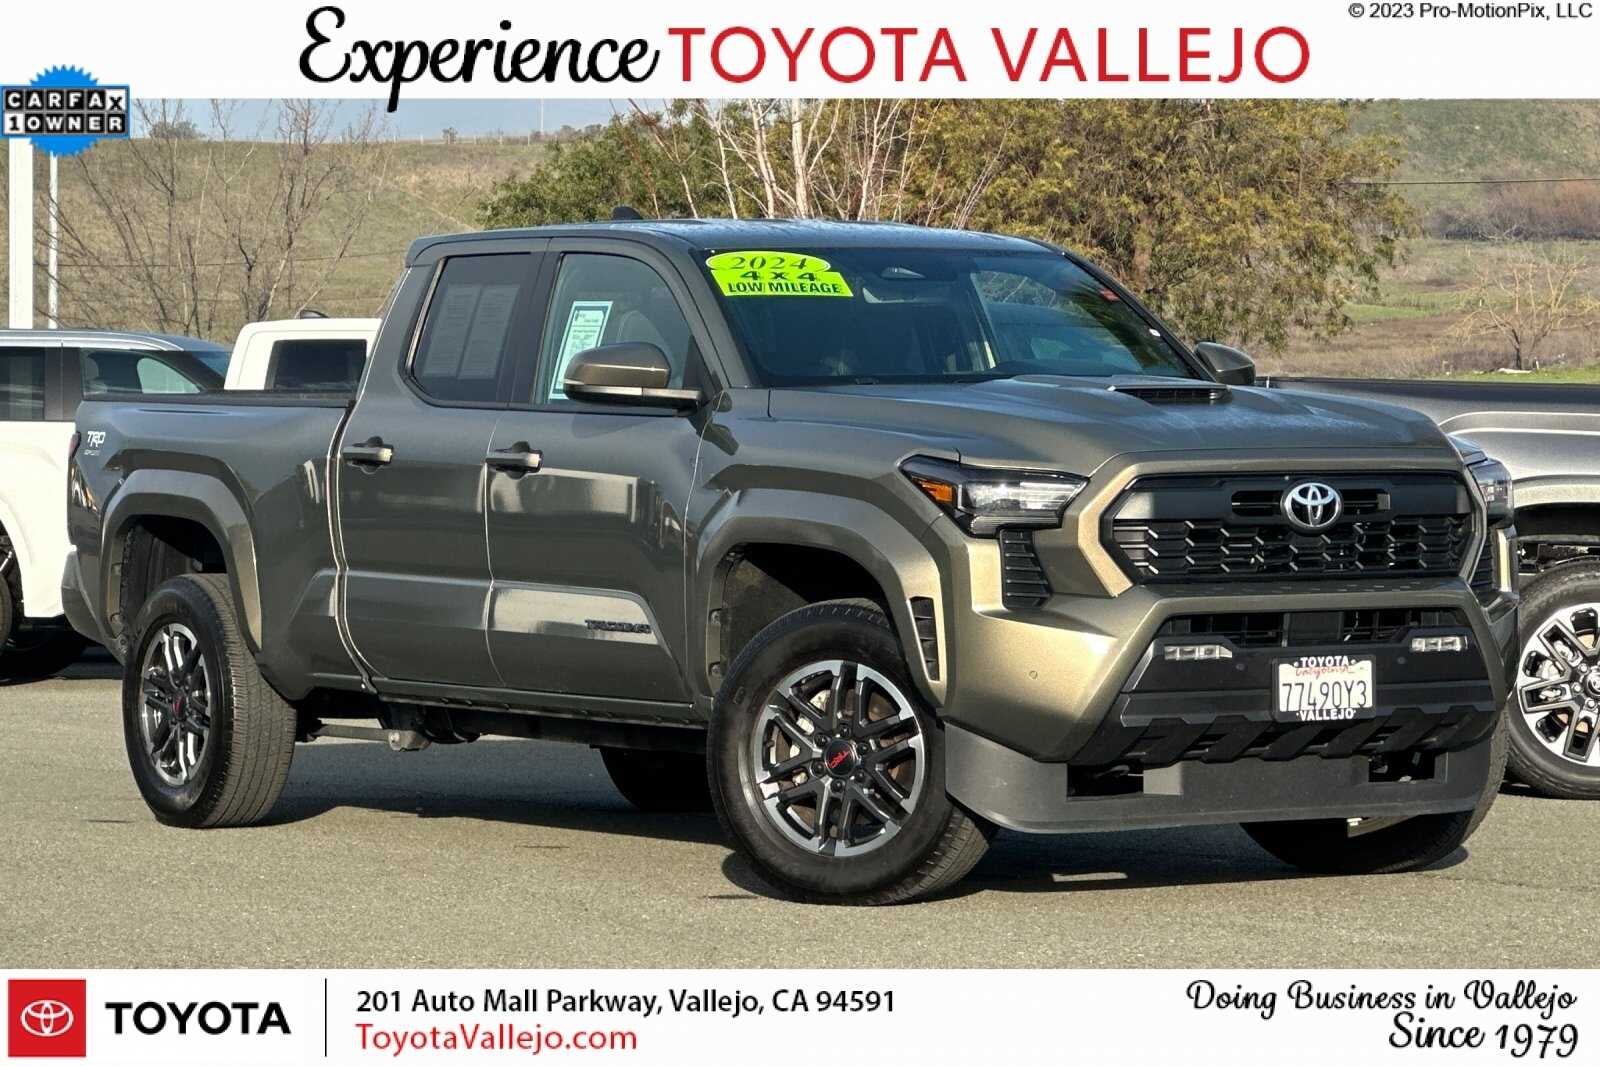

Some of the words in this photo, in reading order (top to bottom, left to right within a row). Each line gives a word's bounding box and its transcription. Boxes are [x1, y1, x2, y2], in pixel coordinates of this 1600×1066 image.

[730, 256, 807, 270] 2024
[728, 282, 763, 293] LOW
[769, 282, 841, 294] MILEAGE
[87, 430, 106, 448] TRD
[1300, 656, 1348, 668] TOYOTA
[1282, 680, 1367, 711] 77490Y3
[1299, 708, 1354, 721] VALLEJO
